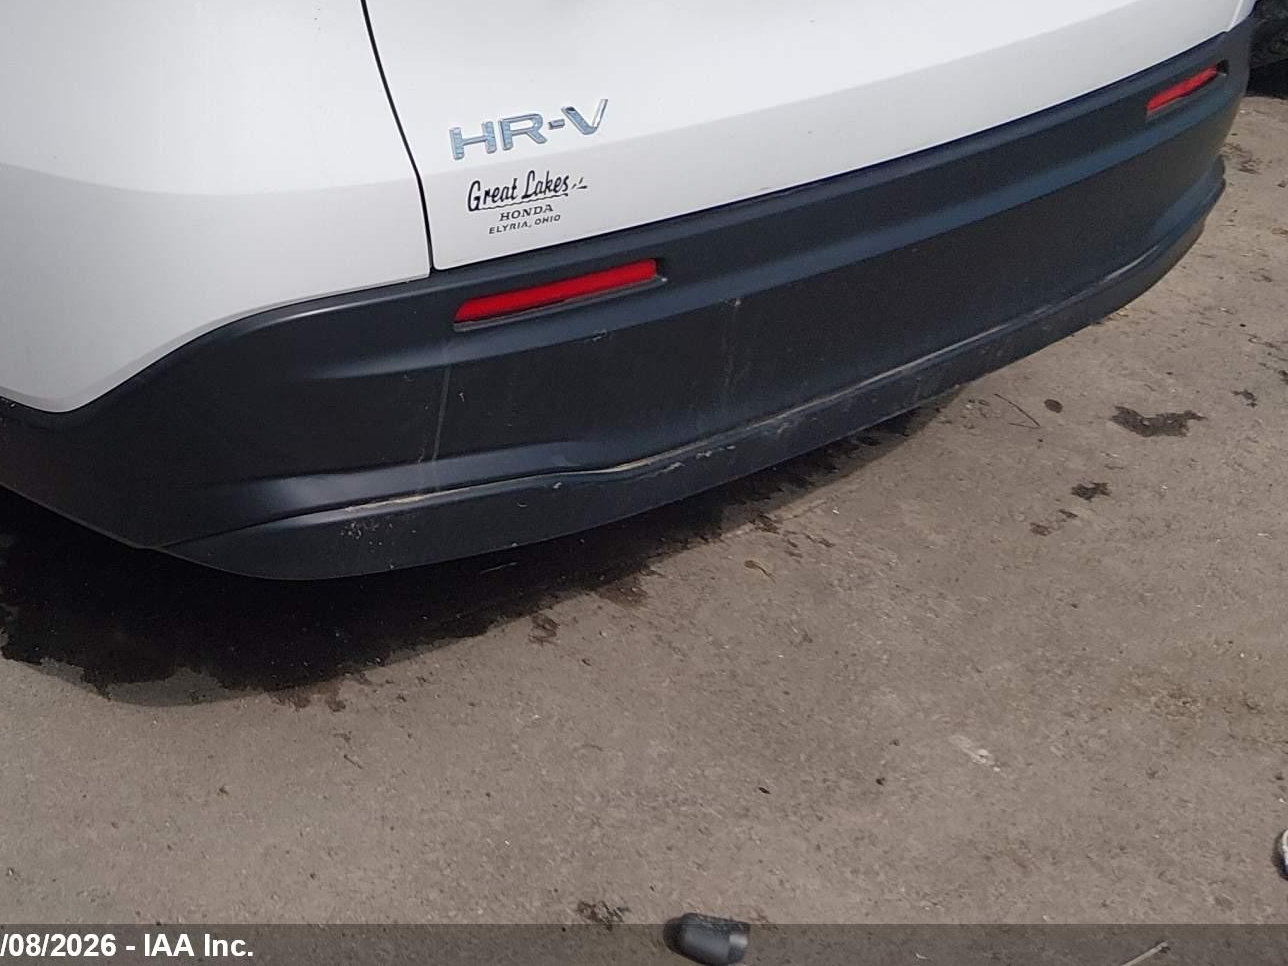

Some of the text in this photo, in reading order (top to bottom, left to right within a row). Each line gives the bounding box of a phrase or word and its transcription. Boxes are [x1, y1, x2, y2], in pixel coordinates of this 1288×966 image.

[449, 99, 608, 160] HR-V
[467, 170, 570, 212] Great Lakes
[488, 214, 561, 234] ELYRIA, OHIO
[499, 204, 553, 221] HONDA
